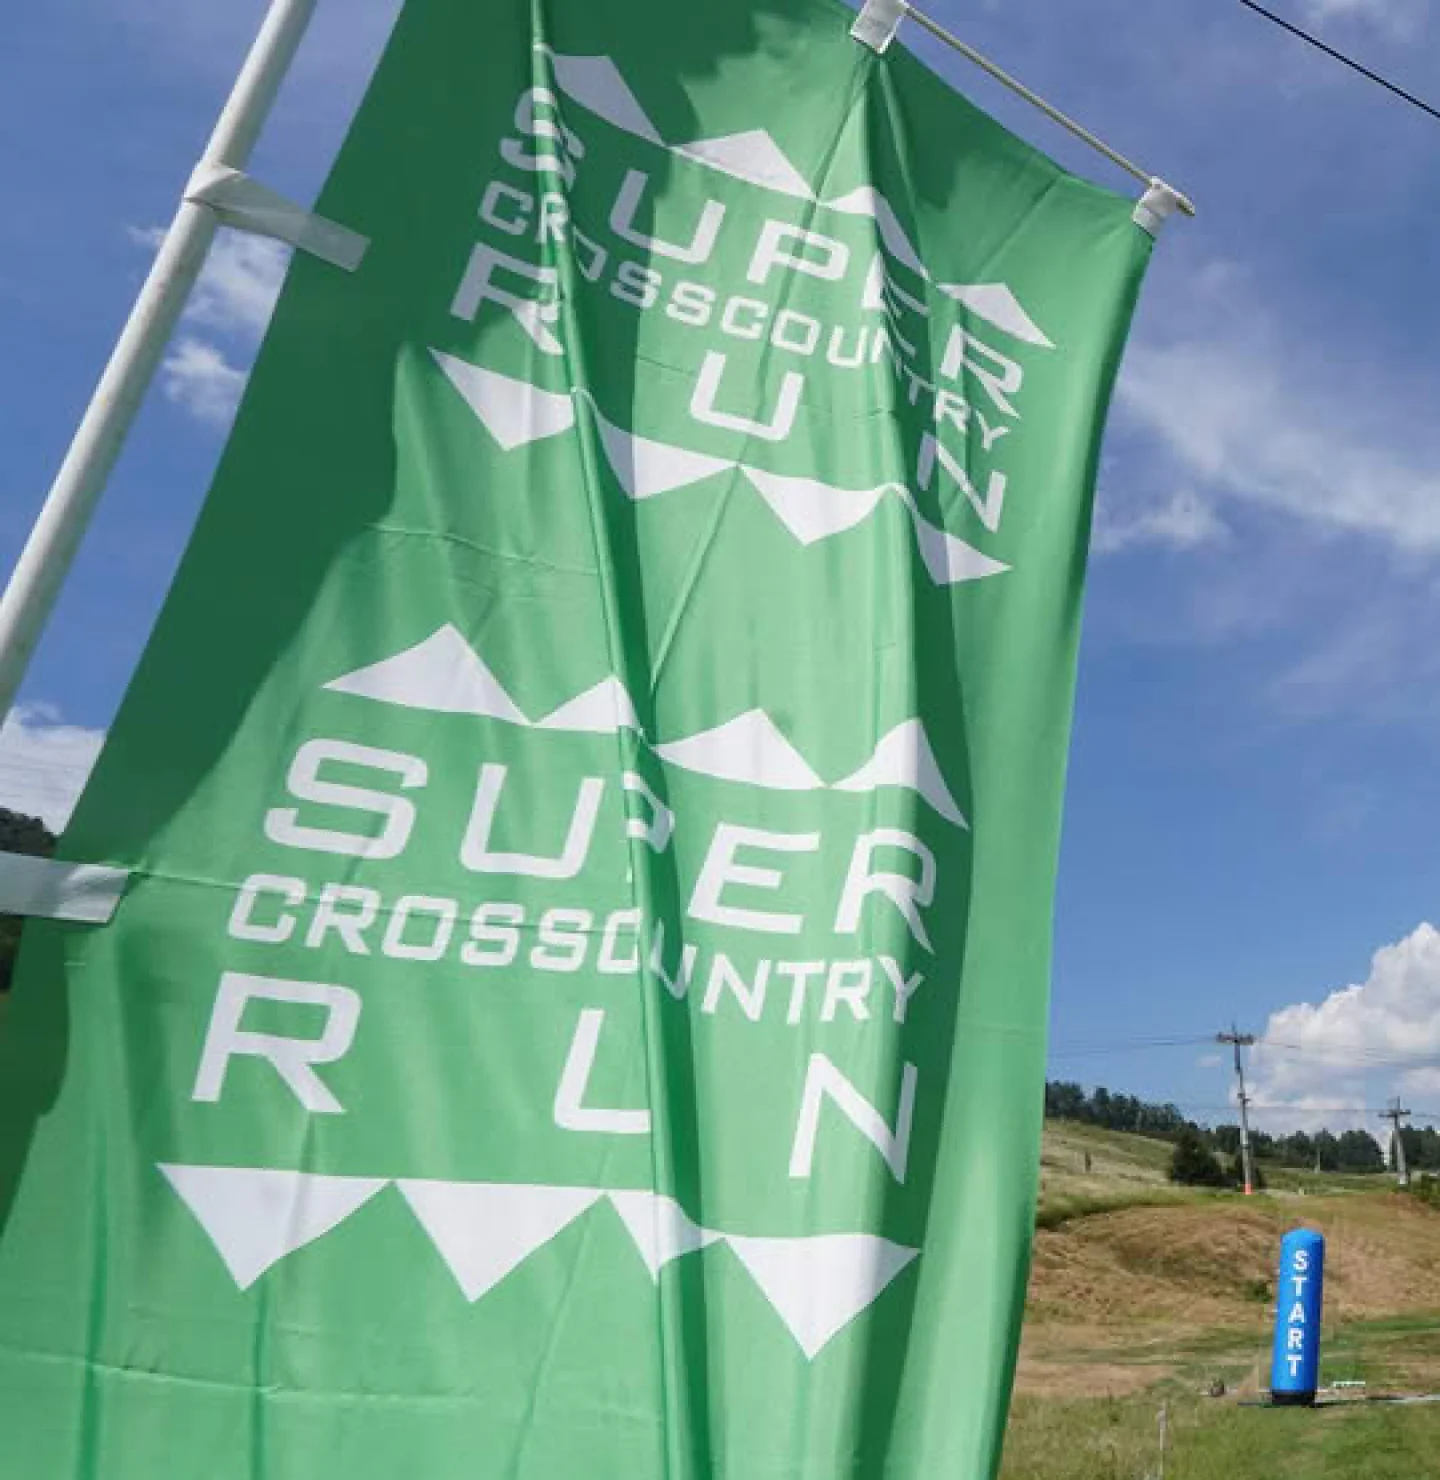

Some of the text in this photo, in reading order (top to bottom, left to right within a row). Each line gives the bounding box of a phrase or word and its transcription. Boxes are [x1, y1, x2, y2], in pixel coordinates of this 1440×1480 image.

[499, 86, 1022, 420] SUPER
[450, 242, 1006, 534] RUN
[227, 873, 924, 1025] CROSSCUNTRY
[1285, 1249, 1309, 1377] START
